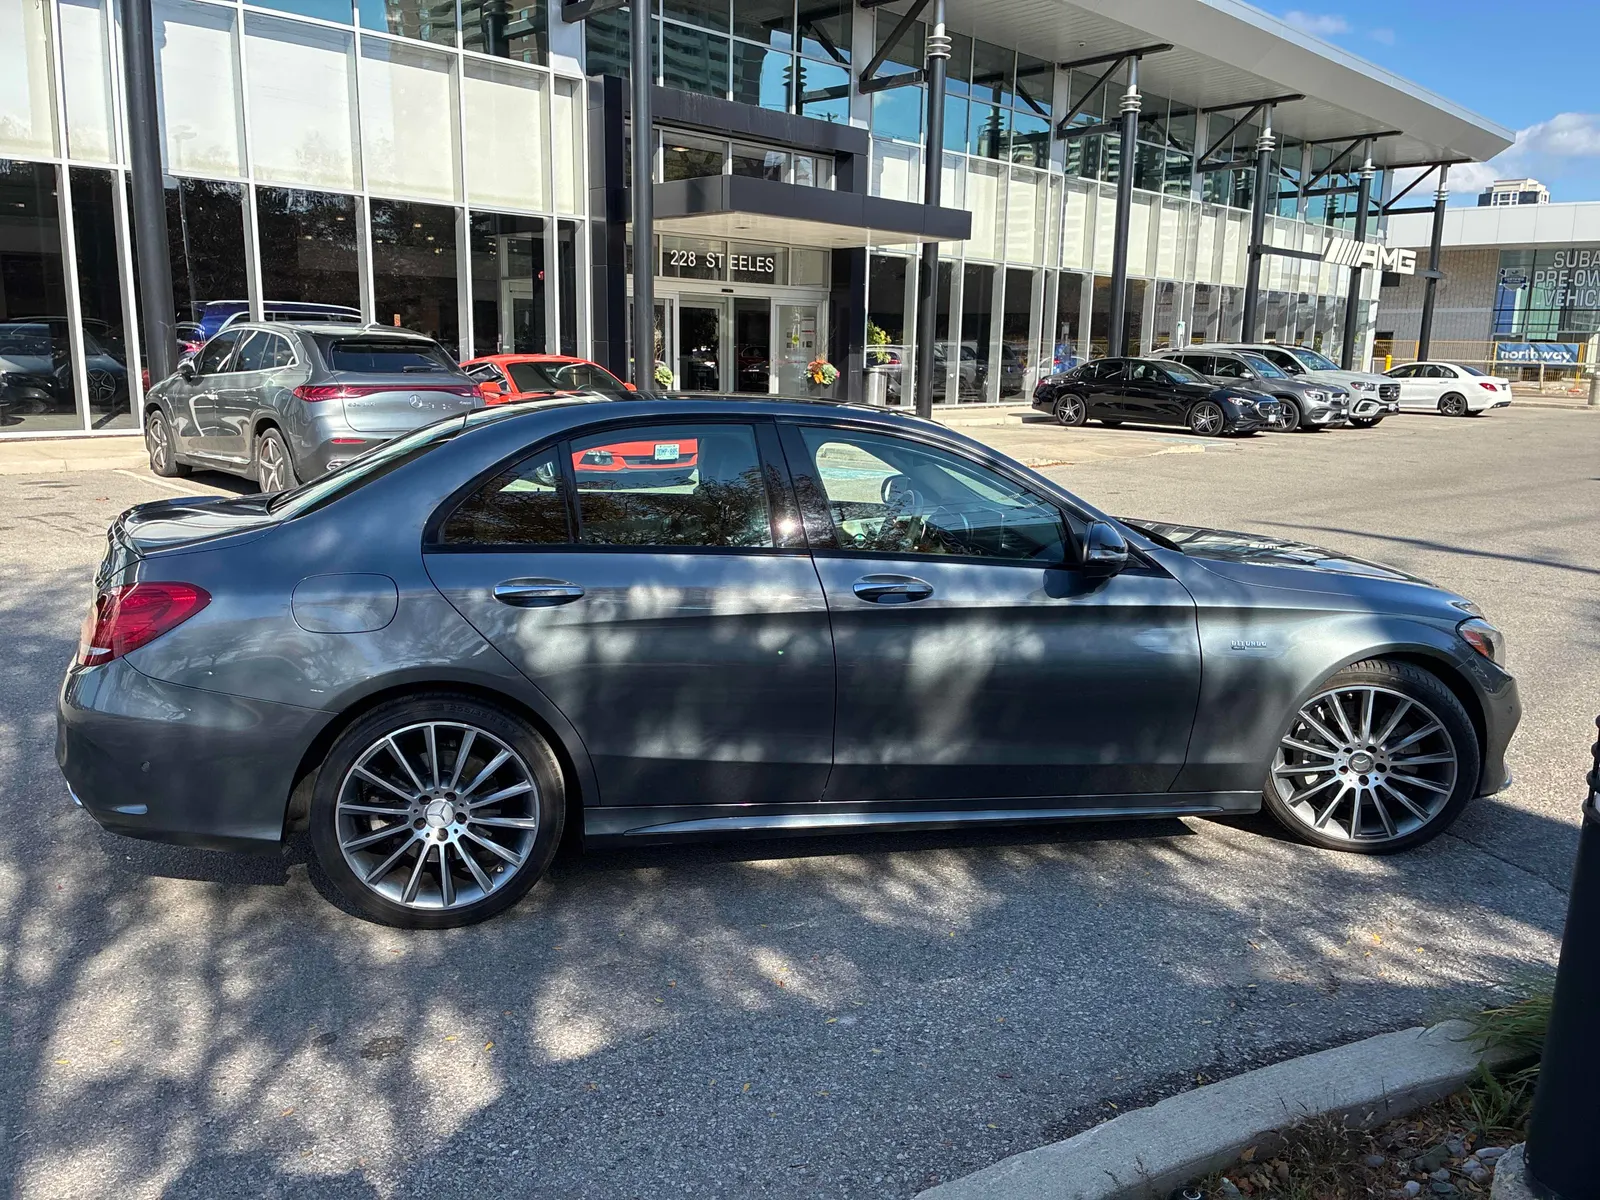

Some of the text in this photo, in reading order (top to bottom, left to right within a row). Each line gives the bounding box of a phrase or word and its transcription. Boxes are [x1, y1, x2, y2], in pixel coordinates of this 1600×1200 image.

[670, 249, 774, 273] 228 STEELES
[1553, 250, 1600, 268] SUBA
[1545, 289, 1600, 307] VEHIC
[1500, 347, 1572, 363] northway
